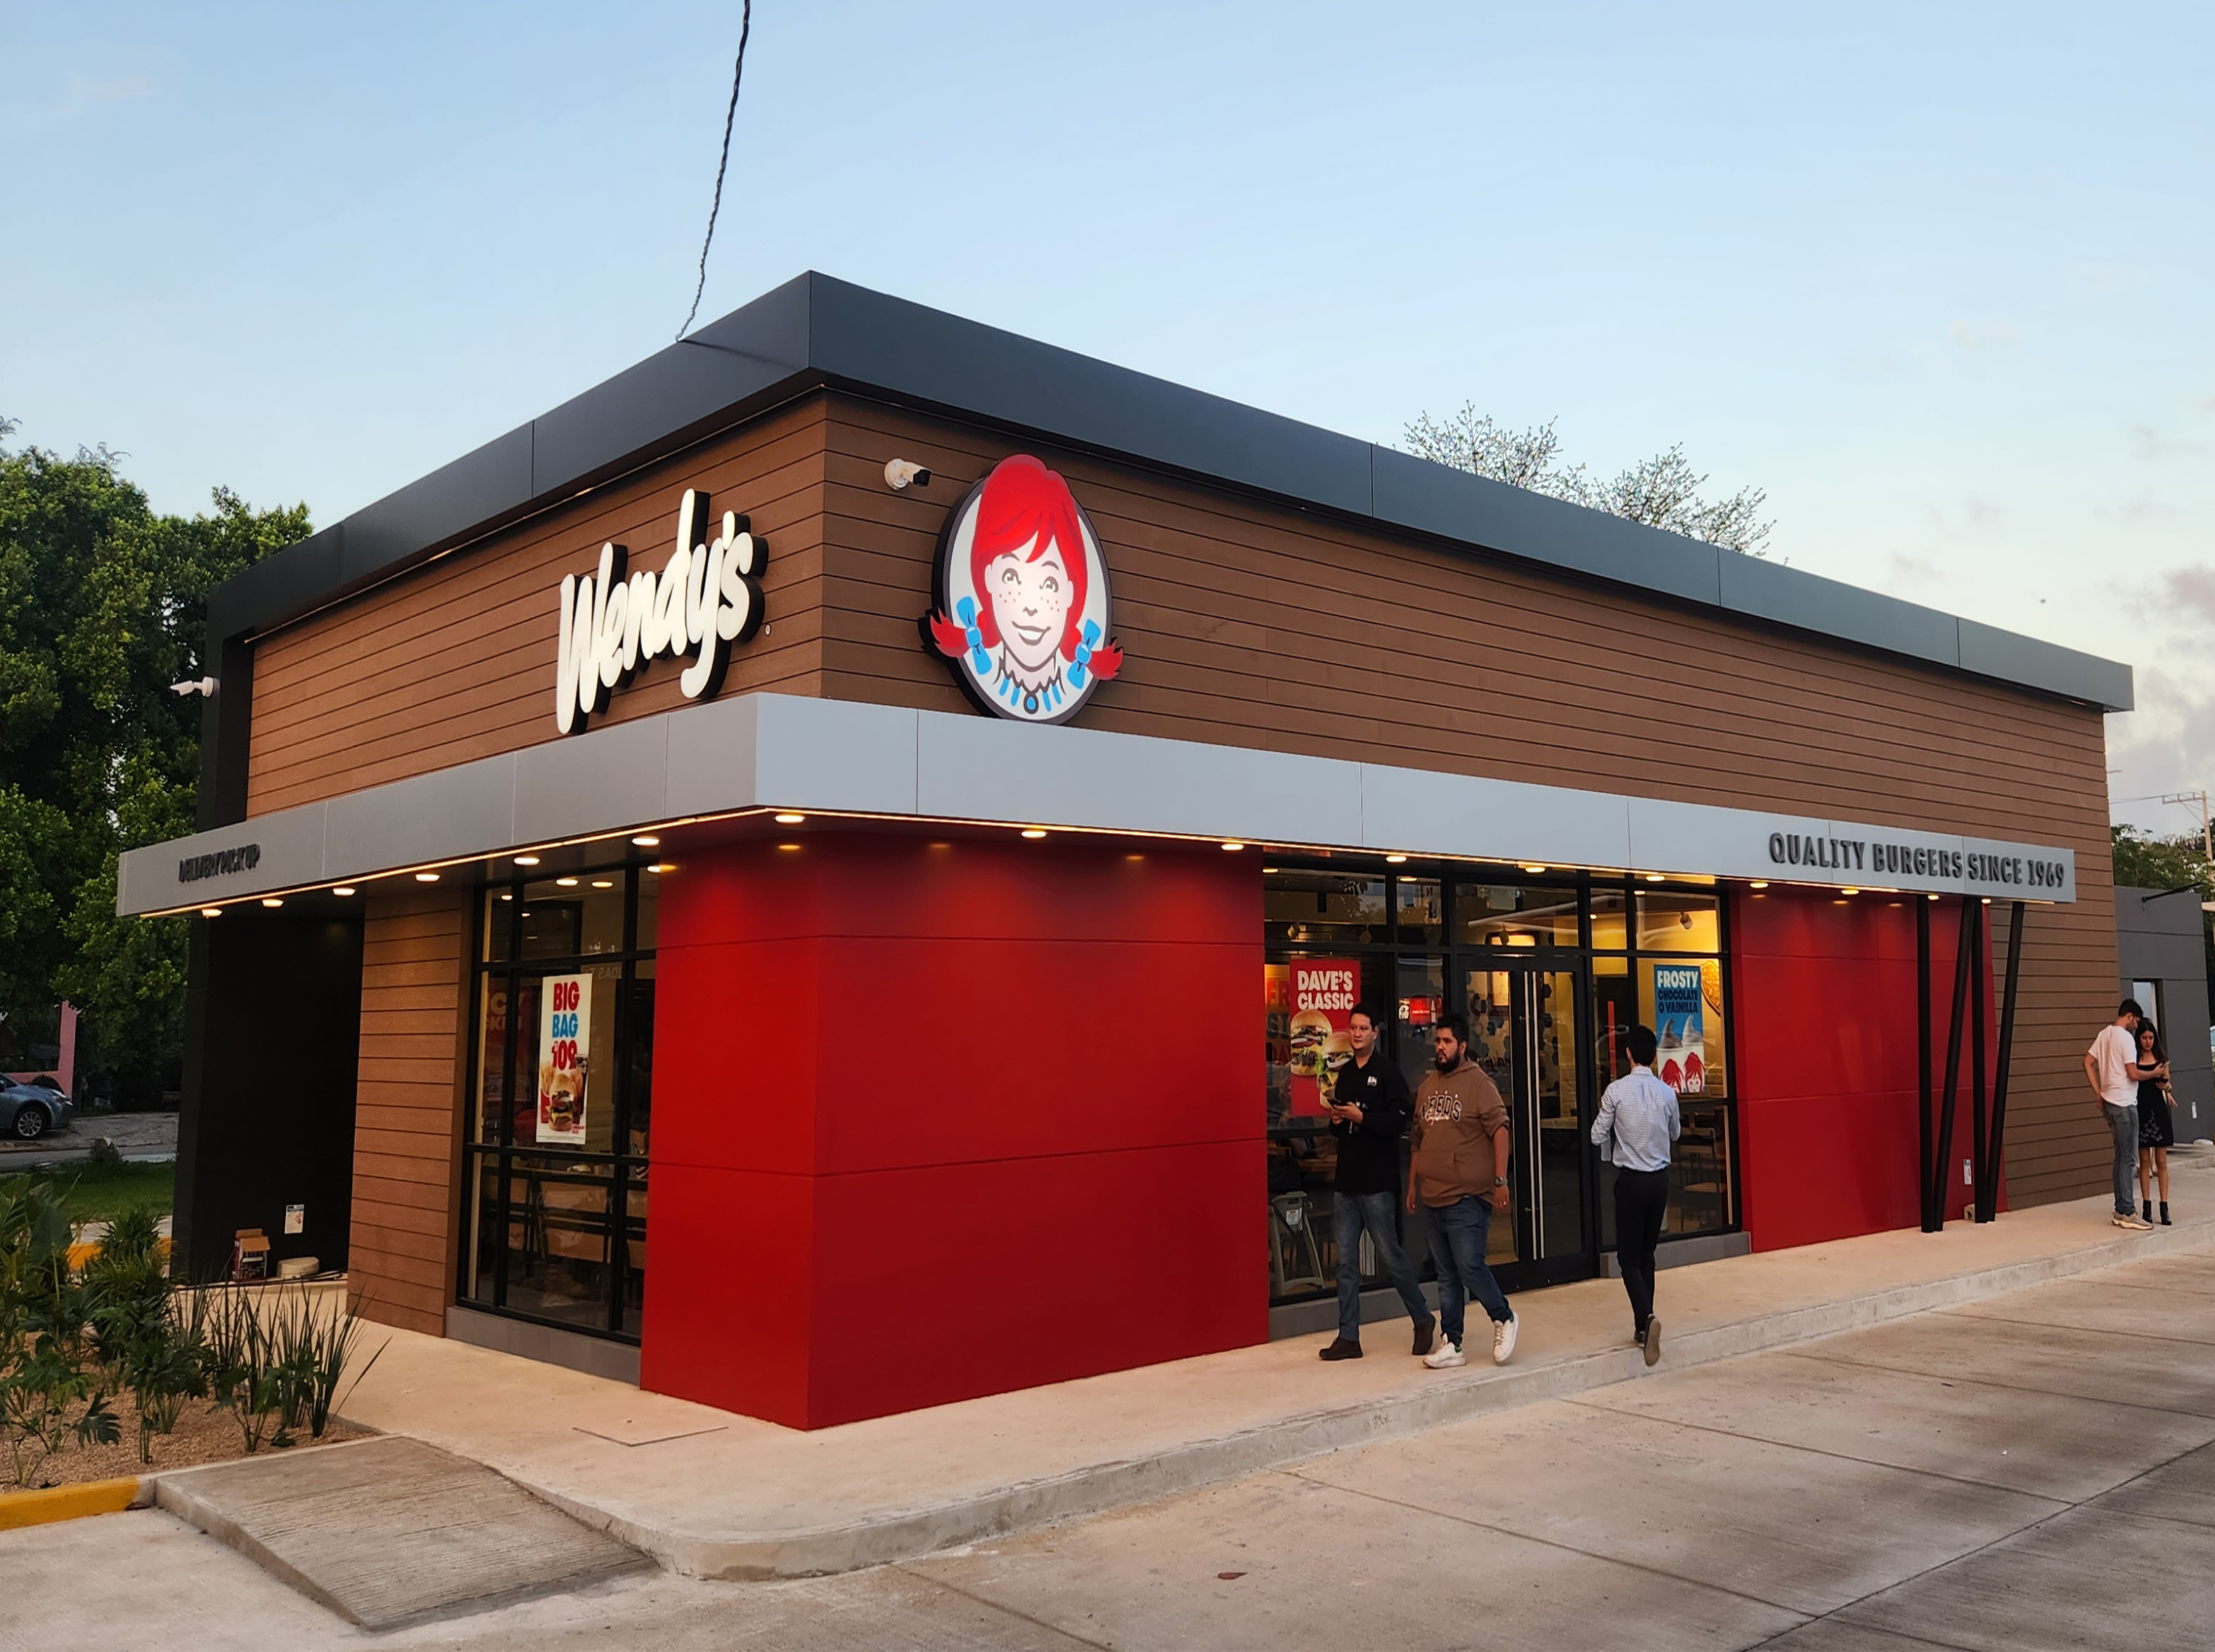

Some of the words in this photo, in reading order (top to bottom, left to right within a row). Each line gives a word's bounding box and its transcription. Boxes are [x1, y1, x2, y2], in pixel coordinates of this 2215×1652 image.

[556, 488, 755, 734] Wendy's
[1769, 832, 1865, 870] QUALITY
[1871, 843, 1963, 879] BURGERS
[1968, 853, 2022, 884] SINCE
[2027, 859, 2065, 888] 1969
[1297, 970, 1353, 991] DAVE'S
[1657, 969, 1698, 988] FROSTY
[553, 981, 580, 1012] BIG
[1297, 992, 1354, 1010] CLASSIC
[1658, 989, 1698, 1001] CHOCOLATE
[1658, 1002, 1665, 1014] O
[1665, 1001, 1698, 1014] VAINILLA
[551, 1012, 579, 1038] BAG
